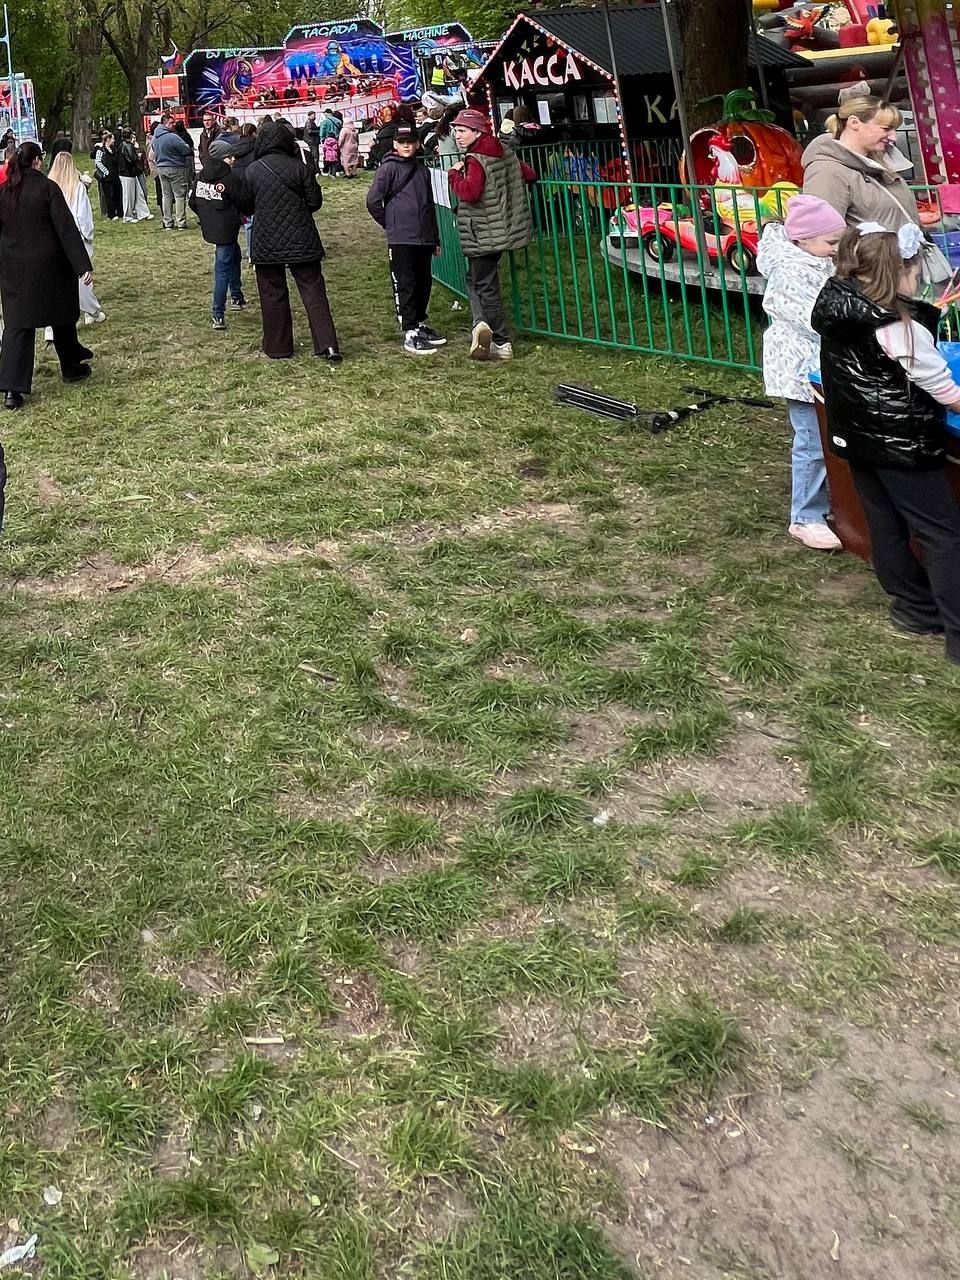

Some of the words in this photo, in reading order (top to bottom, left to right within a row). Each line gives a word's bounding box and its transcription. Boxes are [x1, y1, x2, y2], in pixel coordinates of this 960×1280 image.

[301, 22, 358, 39] TAGADA
[403, 25, 450, 41] MACHINE
[503, 53, 582, 91] КАССА
